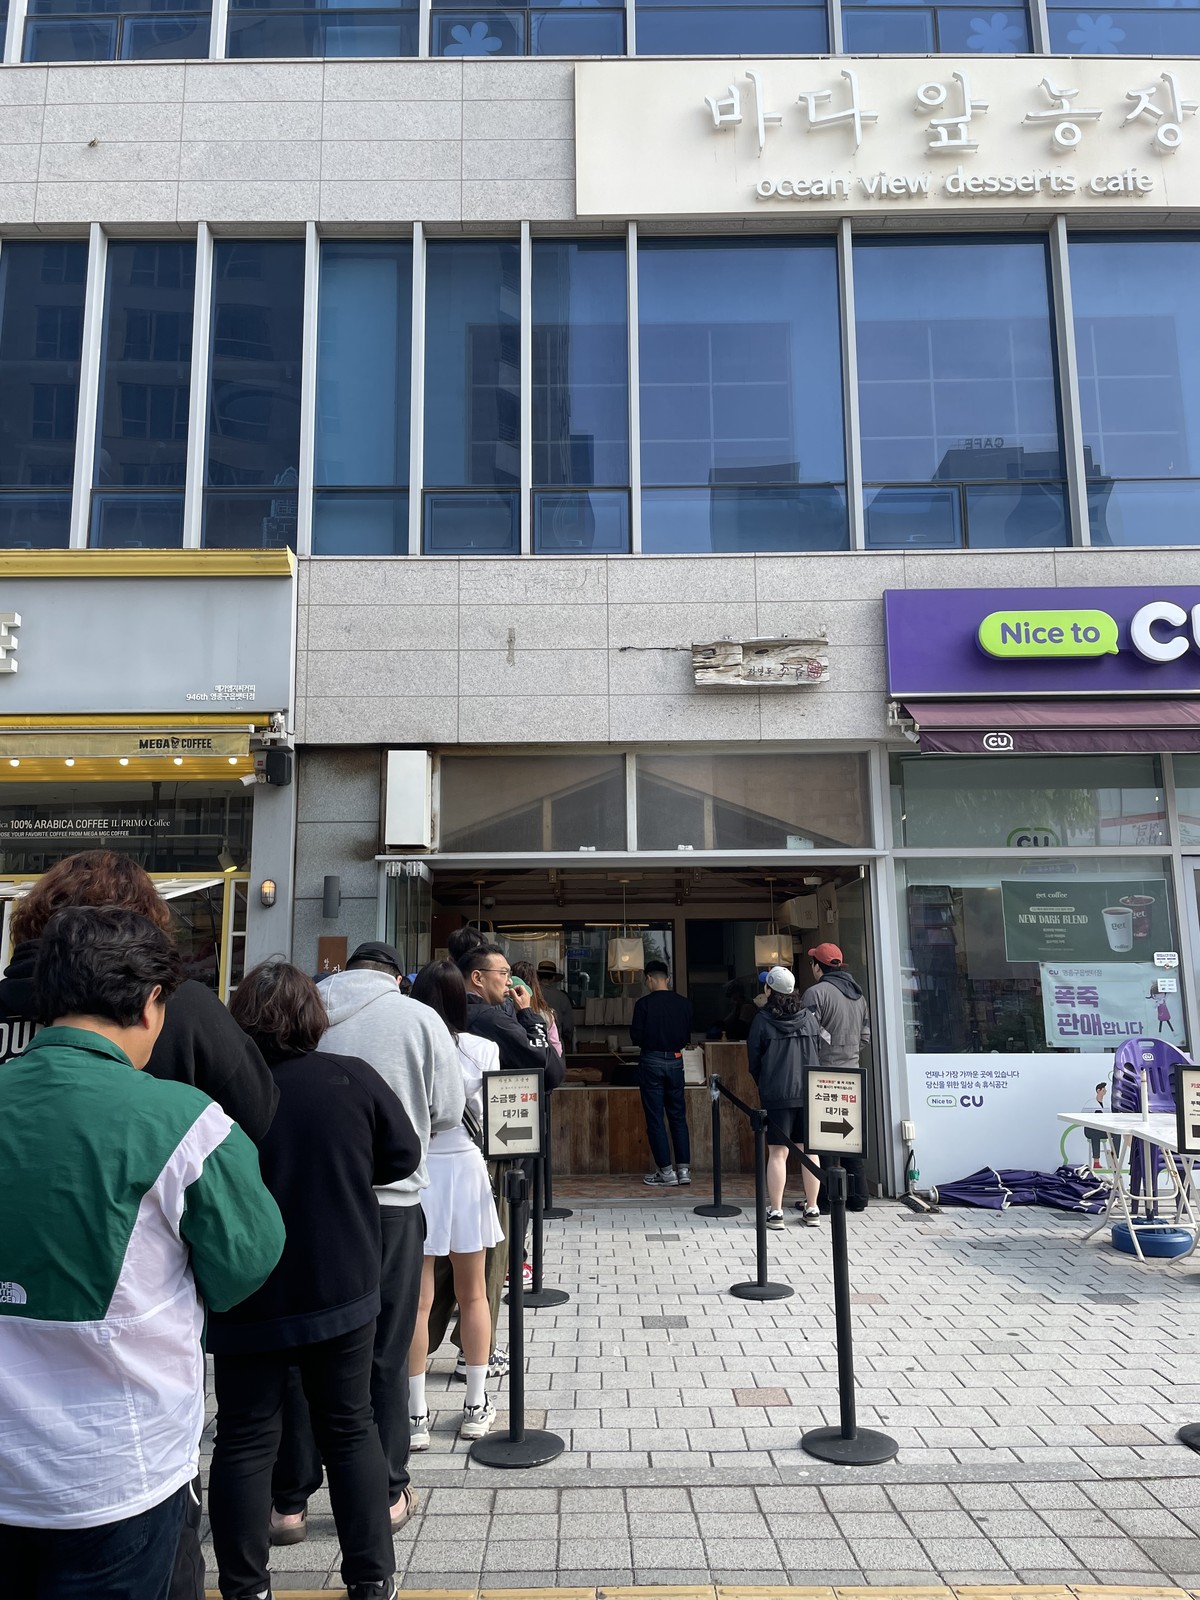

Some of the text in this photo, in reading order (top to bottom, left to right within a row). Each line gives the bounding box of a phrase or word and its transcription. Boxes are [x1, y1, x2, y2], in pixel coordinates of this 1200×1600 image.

[756, 166, 1154, 197] ocean view desserts cafe
[1000, 601, 1200, 663] Nice to C
[186, 693, 208, 701] 946th
[139, 738, 212, 750] MEGA COFFEE
[988, 736, 1008, 747] CU
[10, 819, 33, 829] 100%
[34, 819, 74, 829] ARABICA
[75, 818, 109, 829] COFFEE
[111, 819, 120, 827] IL
[121, 818, 148, 827] PRIMO
[148, 818, 171, 827] Coffee
[1018, 914, 1089, 924] NEW DARK BLEND
[1111, 922, 1127, 931] get
[1054, 985, 1099, 1008] 폭죽
[1056, 1012, 1144, 1036] 판매합니다
[925, 1070, 1020, 1079] 언제나 가장 가까운 곳에 있습니다
[926, 1081, 1008, 1089] 당신을 위한 일상 속 휴식공간
[490, 1092, 538, 1104] 소금빵 결제
[815, 1092, 857, 1103] 소금빵 픽업
[960, 1095, 984, 1108] CU
[503, 1109, 529, 1119] 대기줄
[826, 1107, 849, 1116] 대기줄
